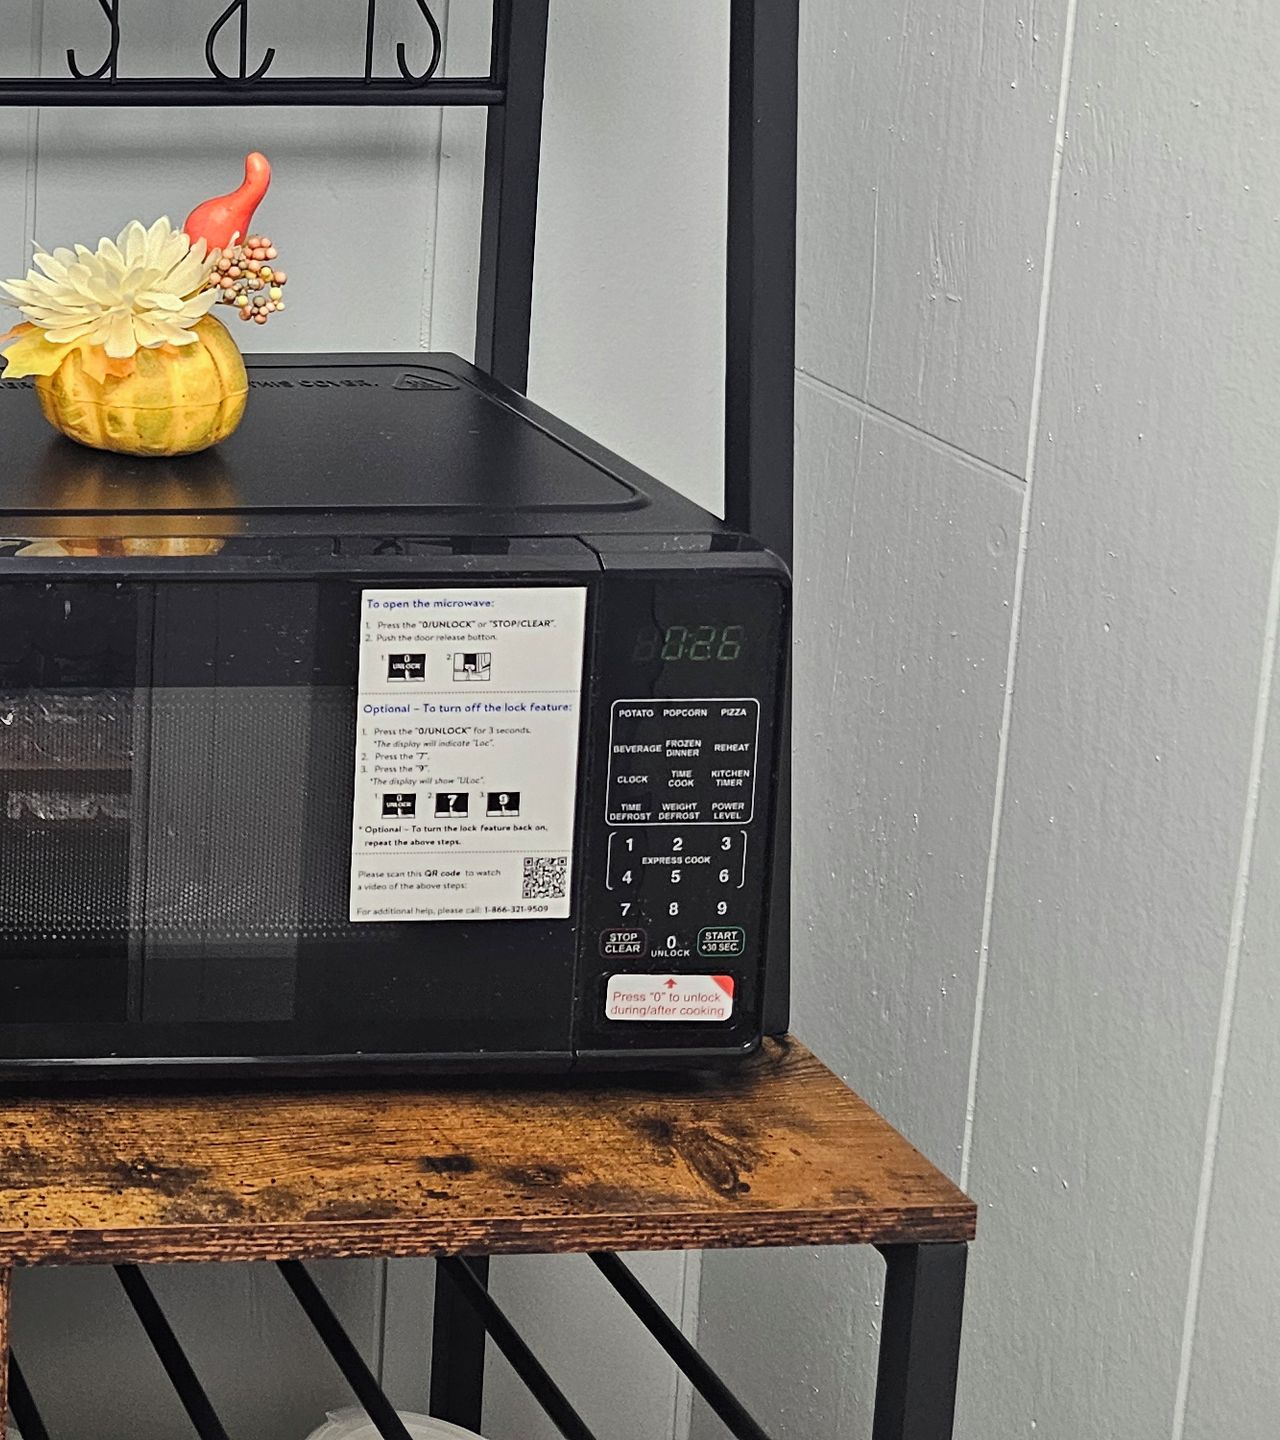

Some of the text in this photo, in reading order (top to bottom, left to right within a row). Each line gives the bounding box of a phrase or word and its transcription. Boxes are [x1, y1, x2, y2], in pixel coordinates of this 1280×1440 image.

[367, 600, 494, 610] To open the microwave:
[365, 634, 373, 642] 2.
[415, 633, 433, 641] door
[436, 633, 465, 641] release
[364, 703, 572, 716] Optional To turn off the lock feature:
[619, 709, 654, 718] POTATO
[663, 709, 708, 717] POPCORN
[721, 708, 747, 716] PIZZA
[613, 745, 662, 753] BEVERAGE
[666, 749, 699, 757] DINNER
[668, 779, 694, 787] COOK
[610, 813, 652, 821] DEFROST
[659, 812, 700, 820] DEFROST
[365, 826, 401, 834] Optional
[626, 838, 633, 851] 1
[672, 837, 683, 851] 2
[721, 837, 731, 850] 3
[685, 856, 710, 864] COOK
[622, 871, 632, 884] 4
[671, 870, 681, 883] 5
[719, 869, 729, 882] 6
[373, 906, 413, 914] additional
[438, 906, 463, 914] please
[485, 905, 548, 914] 1-866-321-9509
[620, 903, 631, 916] 7
[669, 902, 678, 915] 8
[717, 902, 727, 915] 9
[609, 933, 638, 942] STOP
[705, 932, 738, 940] START
[667, 936, 676, 949] 0
[718, 943, 738, 951] SEC.
[605, 945, 640, 953] CLEAR
[651, 949, 690, 957] UNLOCK
[613, 992, 721, 1002] Press "0" to unlock
[611, 1005, 725, 1017] during/after cooking
